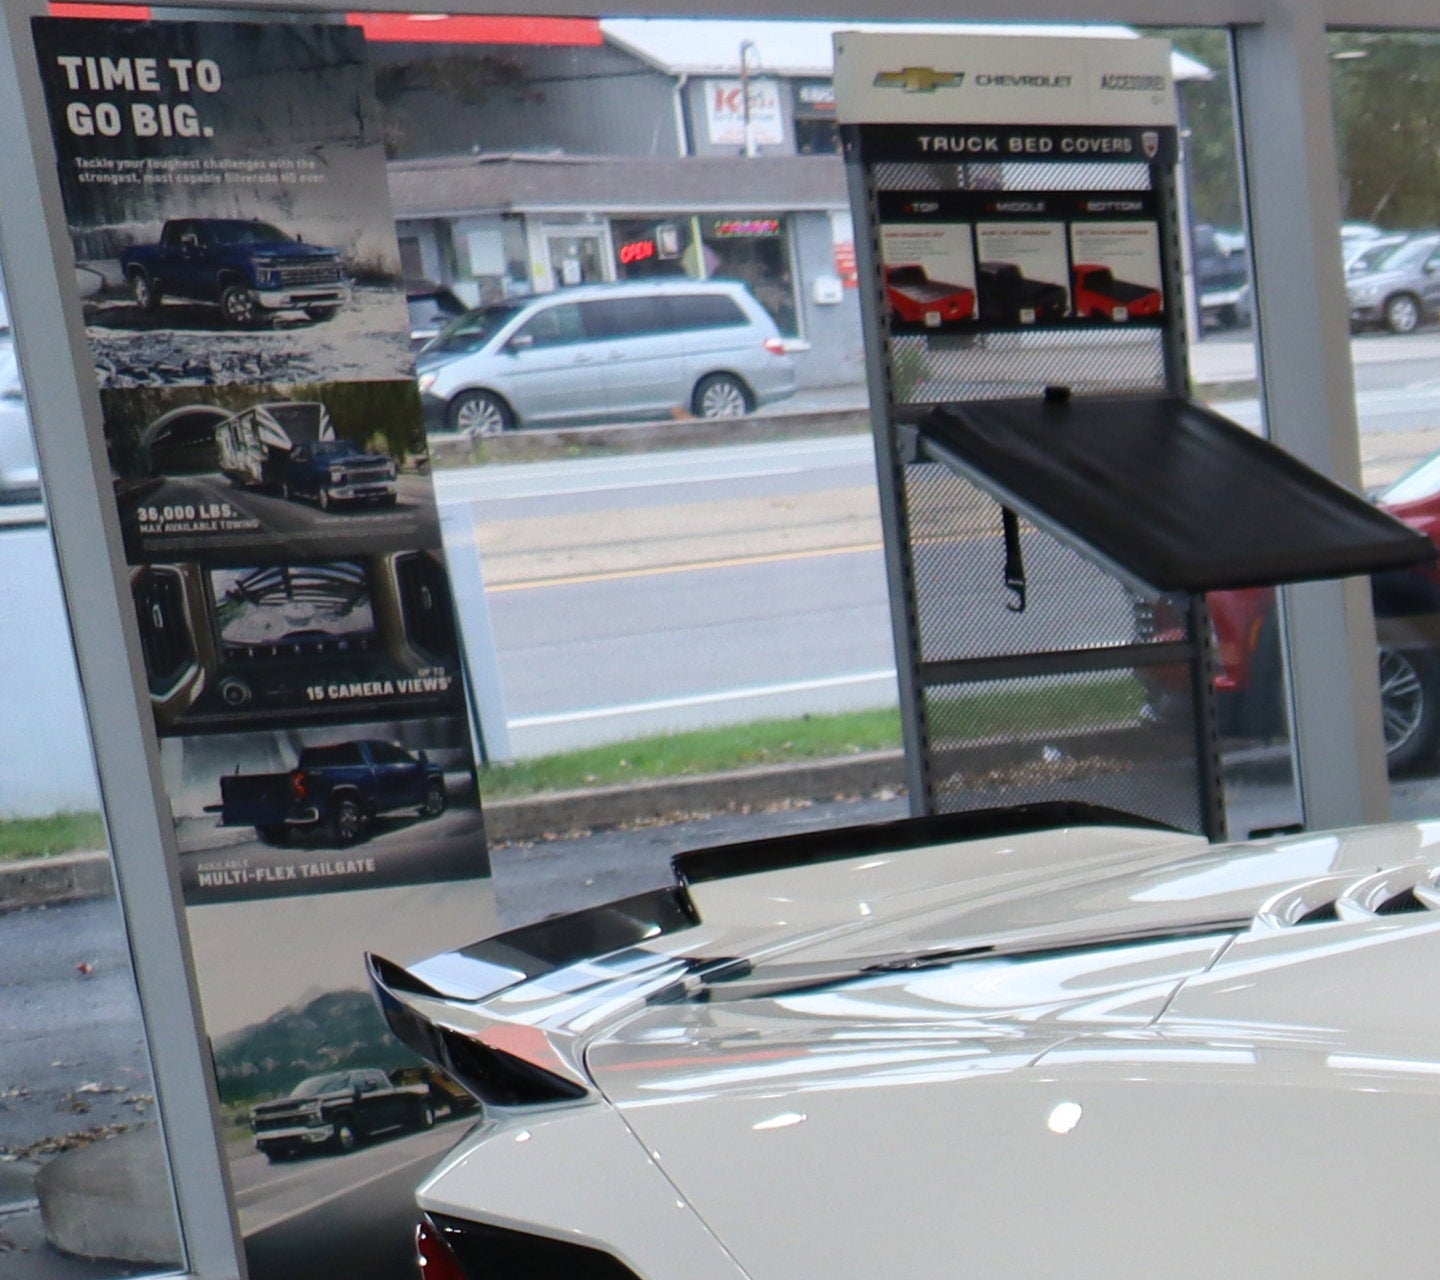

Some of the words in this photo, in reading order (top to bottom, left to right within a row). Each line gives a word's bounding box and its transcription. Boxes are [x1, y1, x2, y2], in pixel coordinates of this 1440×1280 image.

[57, 55, 161, 92] TIME
[168, 58, 222, 93] TO
[974, 73, 1072, 88] CHEVROLET
[66, 101, 122, 136] GO
[131, 103, 214, 137] BIG.
[918, 135, 999, 152] TRUCK
[1008, 137, 1053, 152] BED
[1061, 138, 1132, 153] COVERS
[75, 156, 117, 169] Tackle
[118, 159, 144, 171] your
[145, 157, 200, 171] toughest
[203, 158, 265, 171] challenges
[268, 158, 295, 169] with
[296, 158, 316, 169] the
[143, 173, 172, 183] most
[911, 202, 940, 213] TOP
[995, 201, 1047, 213] MIDDLE
[1086, 201, 1143, 212] BOTTOM
[619, 240, 654, 264] OPEN
[199, 503, 237, 520] LBS.
[140, 522, 163, 533] MAX
[164, 520, 218, 533] AVAILABLE
[306, 685, 325, 701] 15
[328, 681, 395, 699] CAMERA
[198, 864, 297, 887] MULTI-FLEX
[300, 857, 375, 878] TAILGATE
